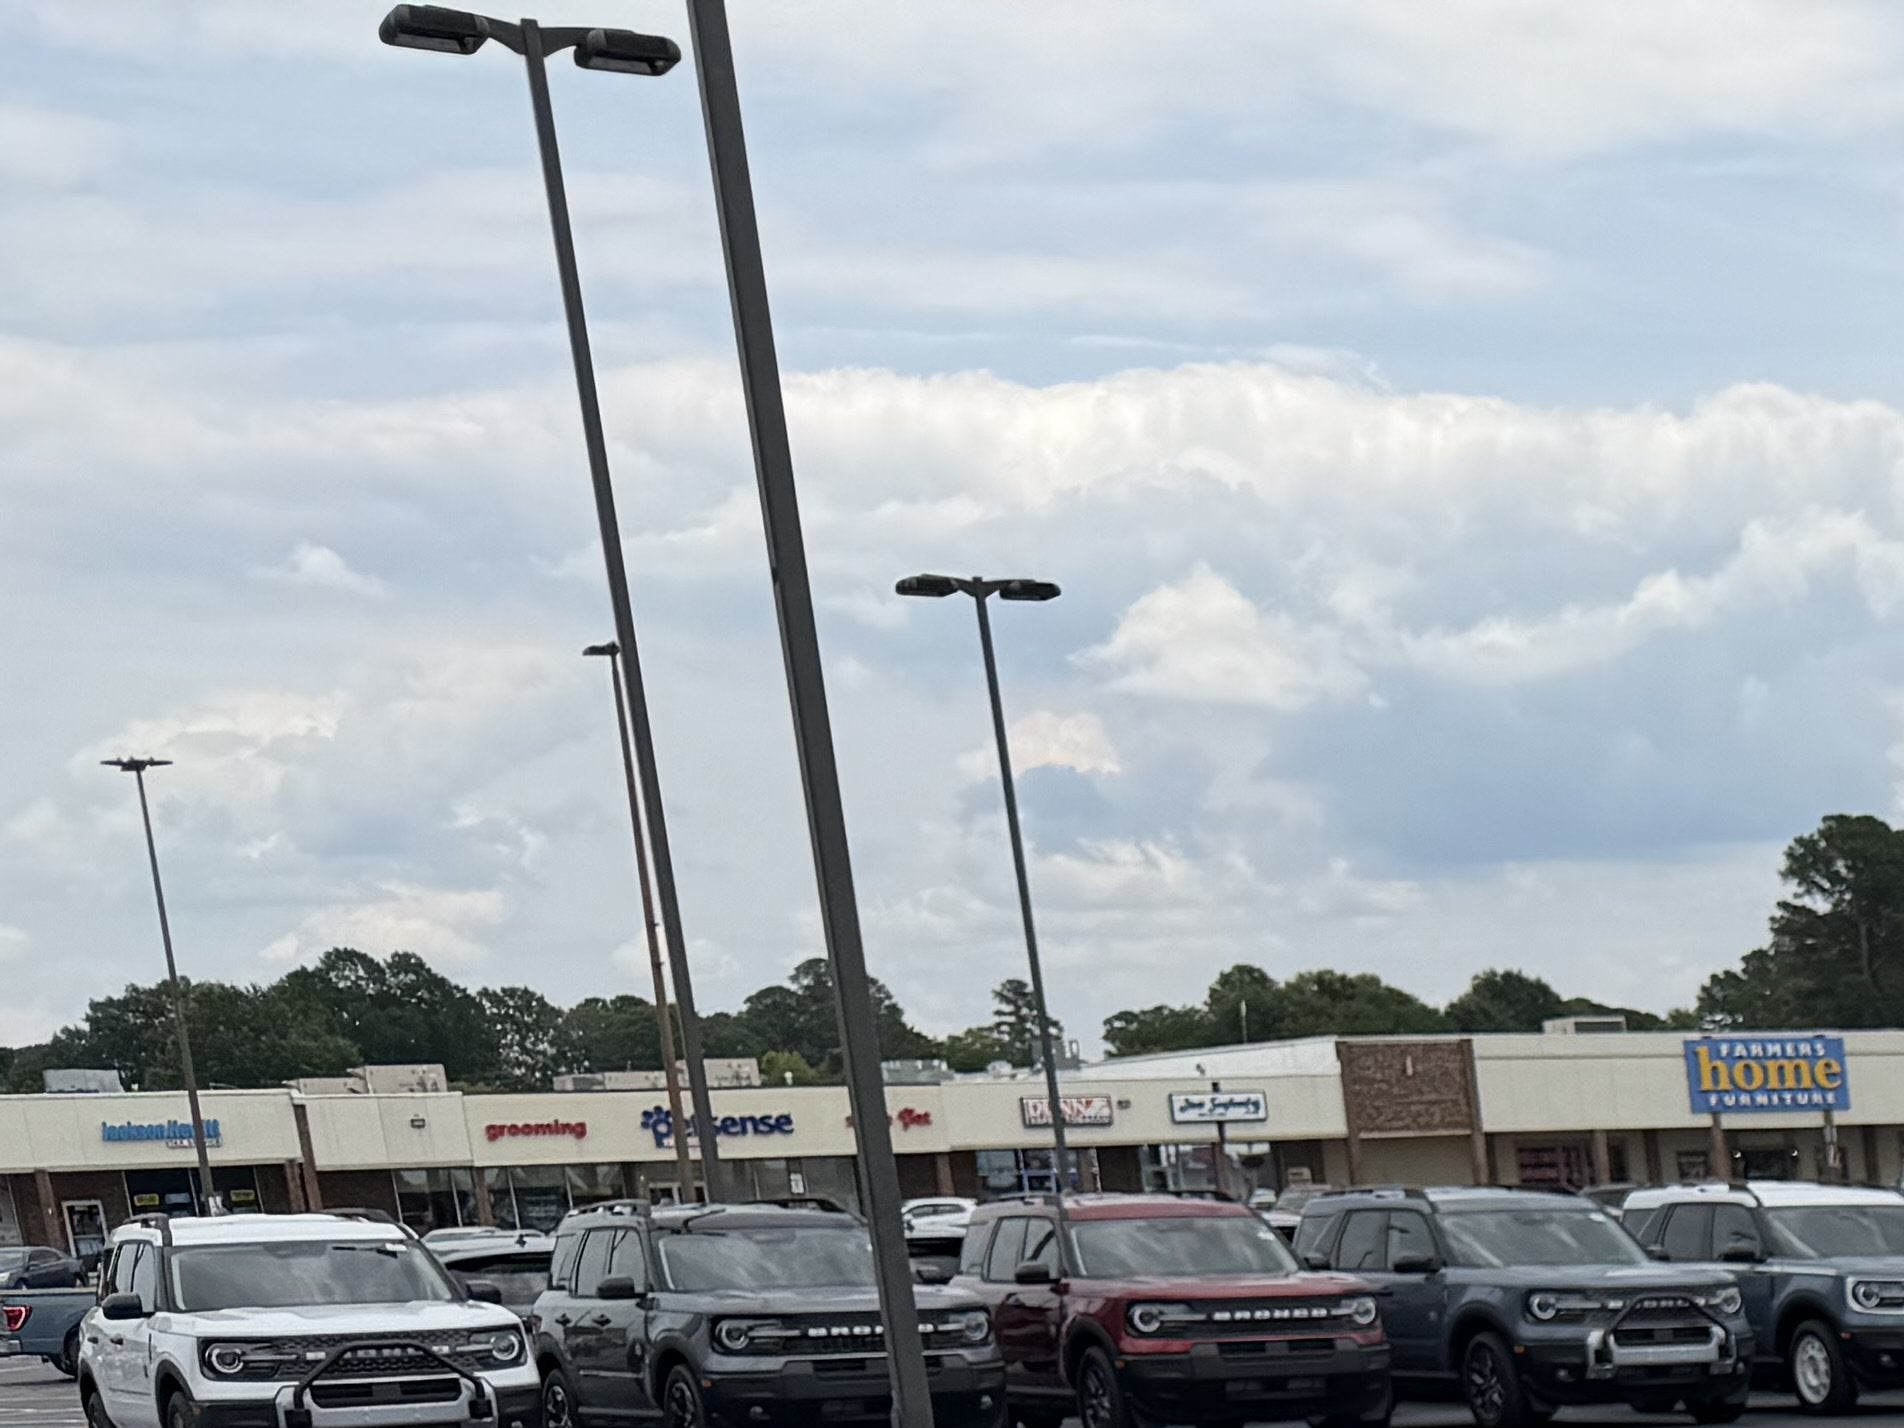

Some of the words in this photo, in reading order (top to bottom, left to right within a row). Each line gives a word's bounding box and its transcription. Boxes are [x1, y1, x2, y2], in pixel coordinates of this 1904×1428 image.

[1720, 1042, 1826, 1058] FARMERS
[1694, 1045, 1842, 1091] home
[1708, 1091, 1837, 1107] FURNITURE
[484, 1118, 588, 1142] grooming
